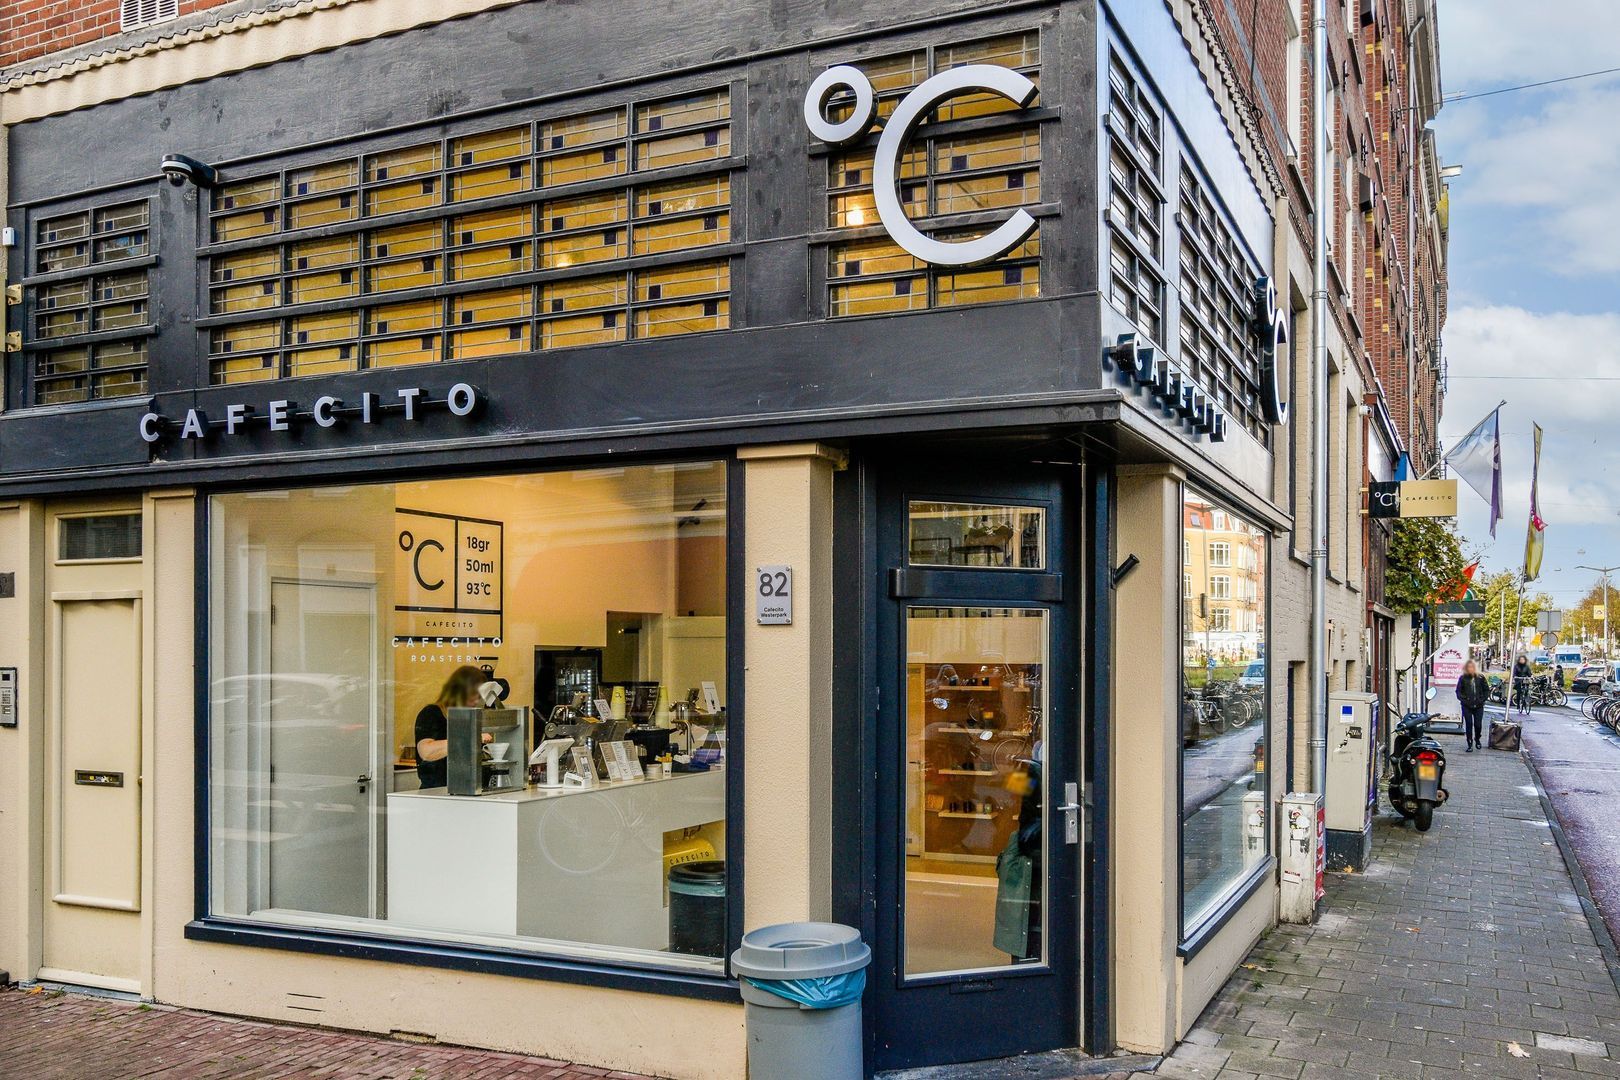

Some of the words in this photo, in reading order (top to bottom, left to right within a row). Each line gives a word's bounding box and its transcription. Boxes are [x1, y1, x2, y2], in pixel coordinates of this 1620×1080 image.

[139, 382, 477, 442] CAFECITO
[466, 535, 490, 552] 18gr
[465, 559, 494, 573] 50ml
[466, 582, 491, 595] 93°C
[760, 572, 788, 597] 82
[425, 620, 474, 628] CAFECITO
[391, 637, 502, 648] CAFECITO
[411, 654, 481, 663] ROASTERY
[669, 851, 710, 865] CAFECITO
